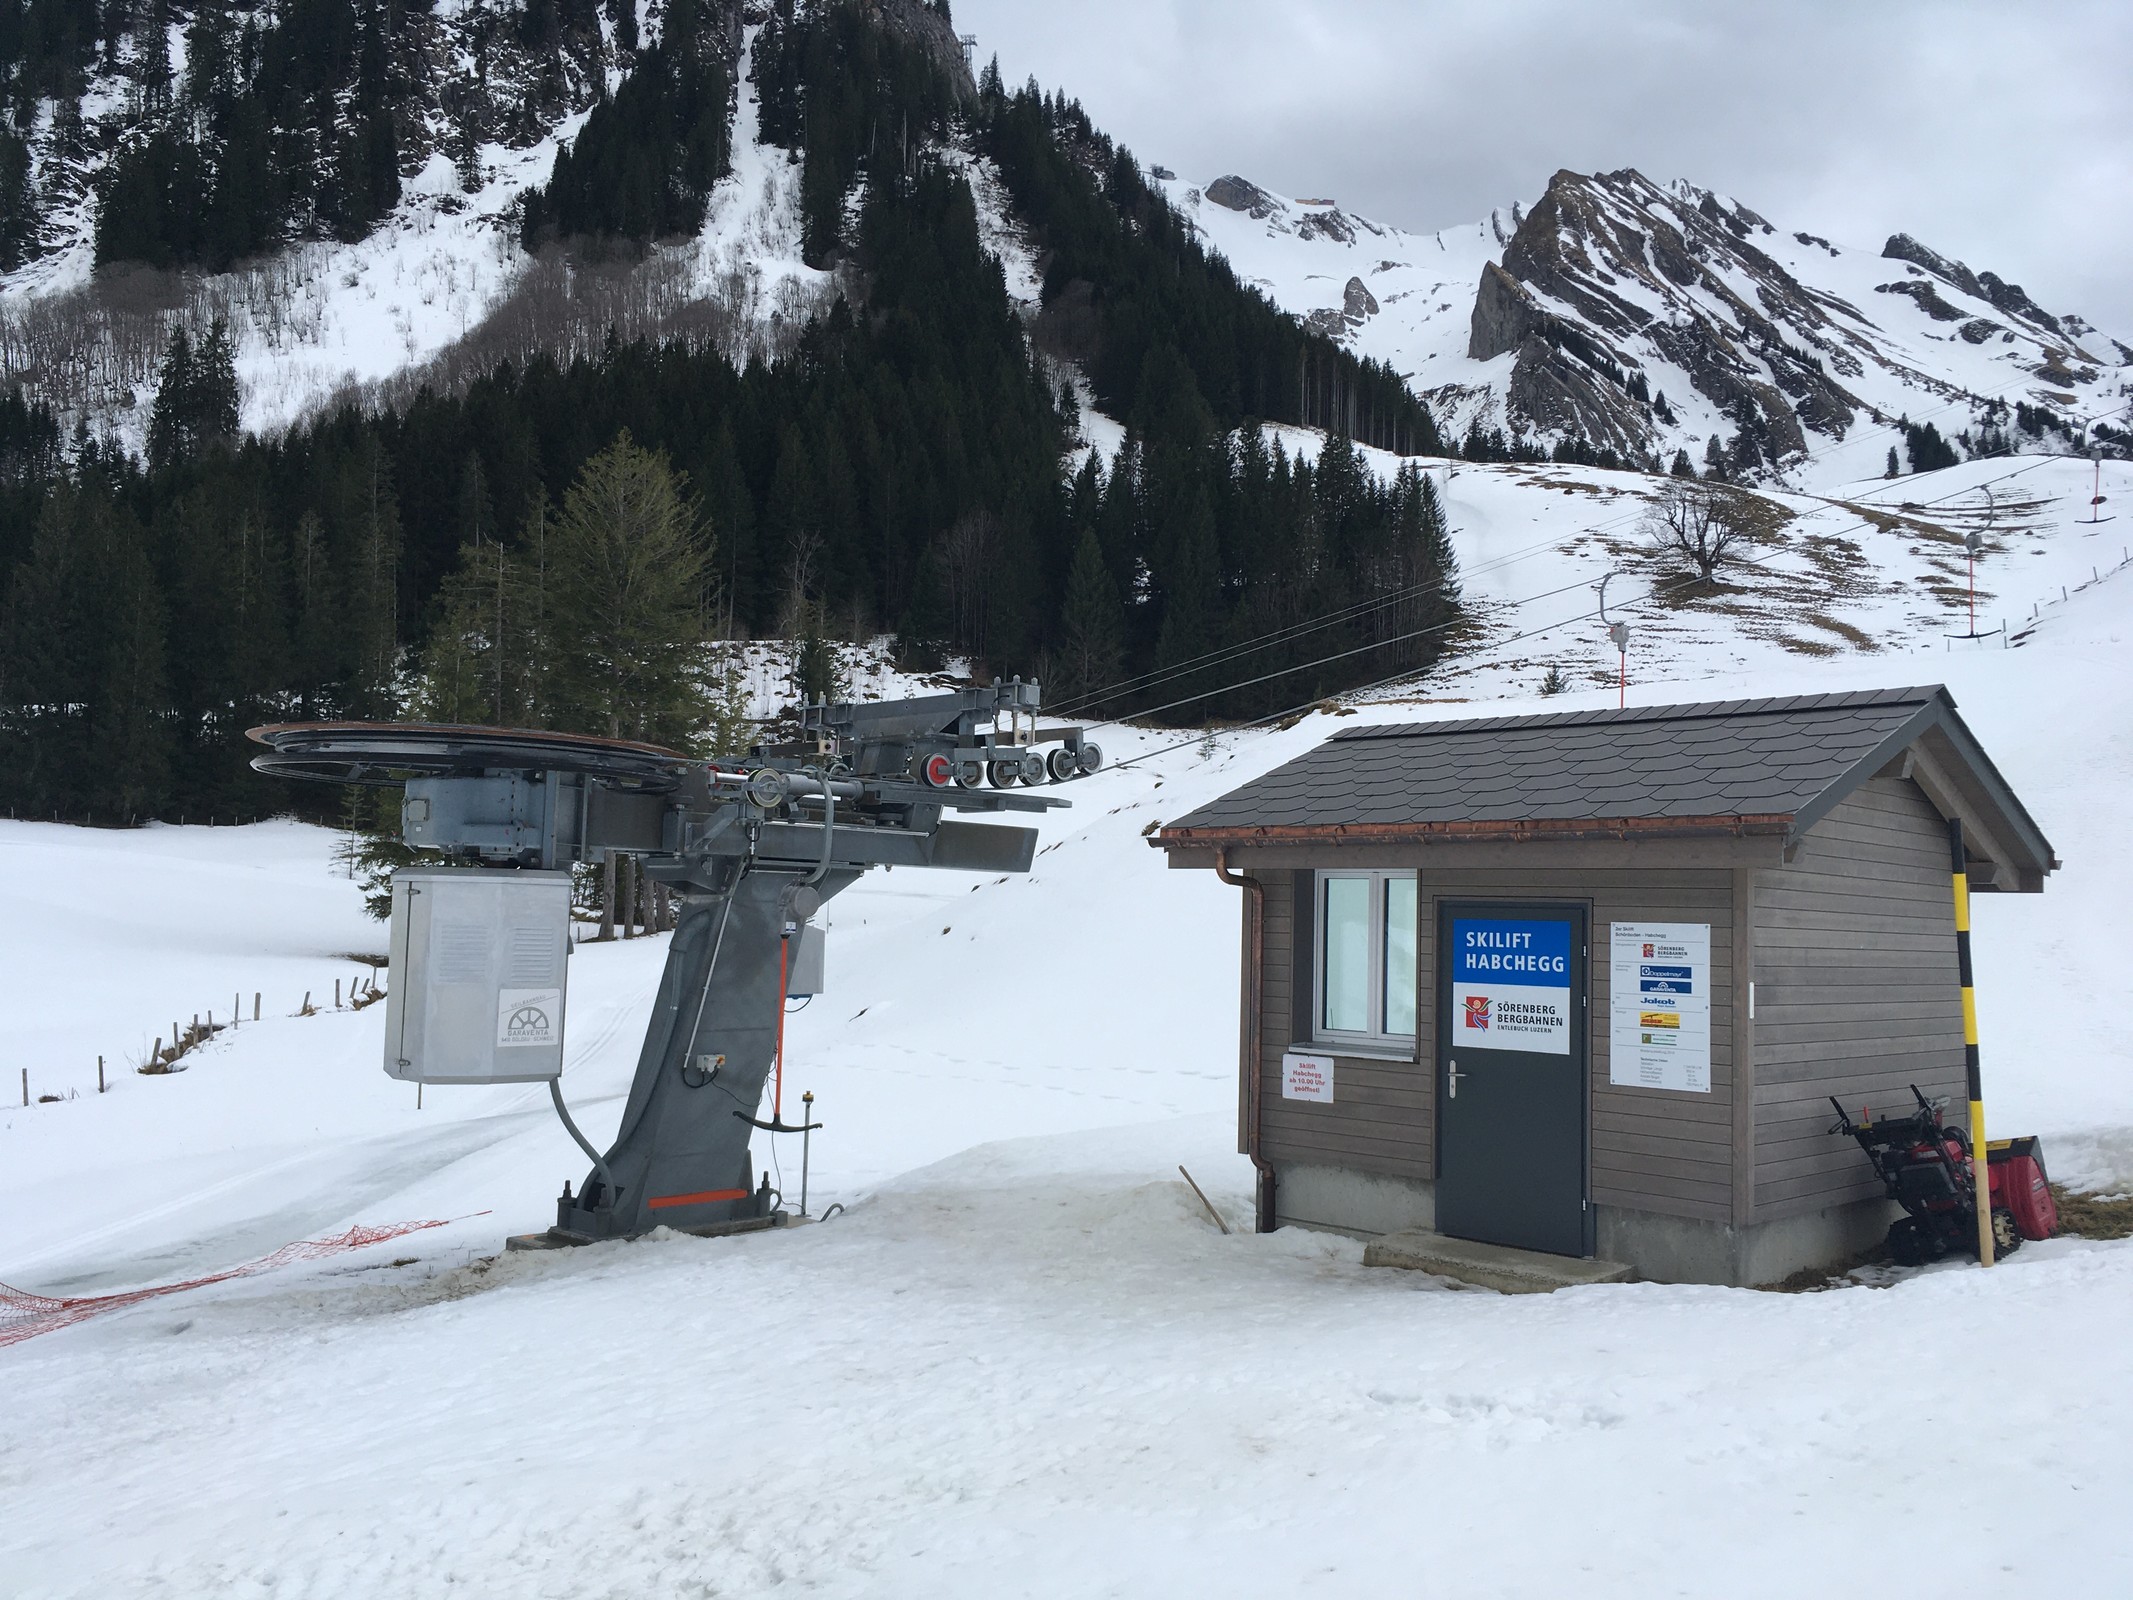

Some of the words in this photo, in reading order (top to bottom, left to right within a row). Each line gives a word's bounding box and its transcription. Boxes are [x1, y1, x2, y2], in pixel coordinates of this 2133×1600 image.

[1466, 931, 1532, 949] SKILIFT
[1466, 953, 1564, 973] HABCHEGG
[1640, 997, 1676, 1005] Jakob
[1497, 1001, 1556, 1015] SÖRENBERG
[1497, 1013, 1563, 1027] BERGBAHNEN
[507, 1029, 549, 1037] GARAVENTA
[1497, 1024, 1529, 1032] ENTLEBUCH
[1530, 1026, 1552, 1034] LUZERN
[1299, 1062, 1316, 1070] Skilift
[1292, 1070, 1322, 1079] Habchegg
